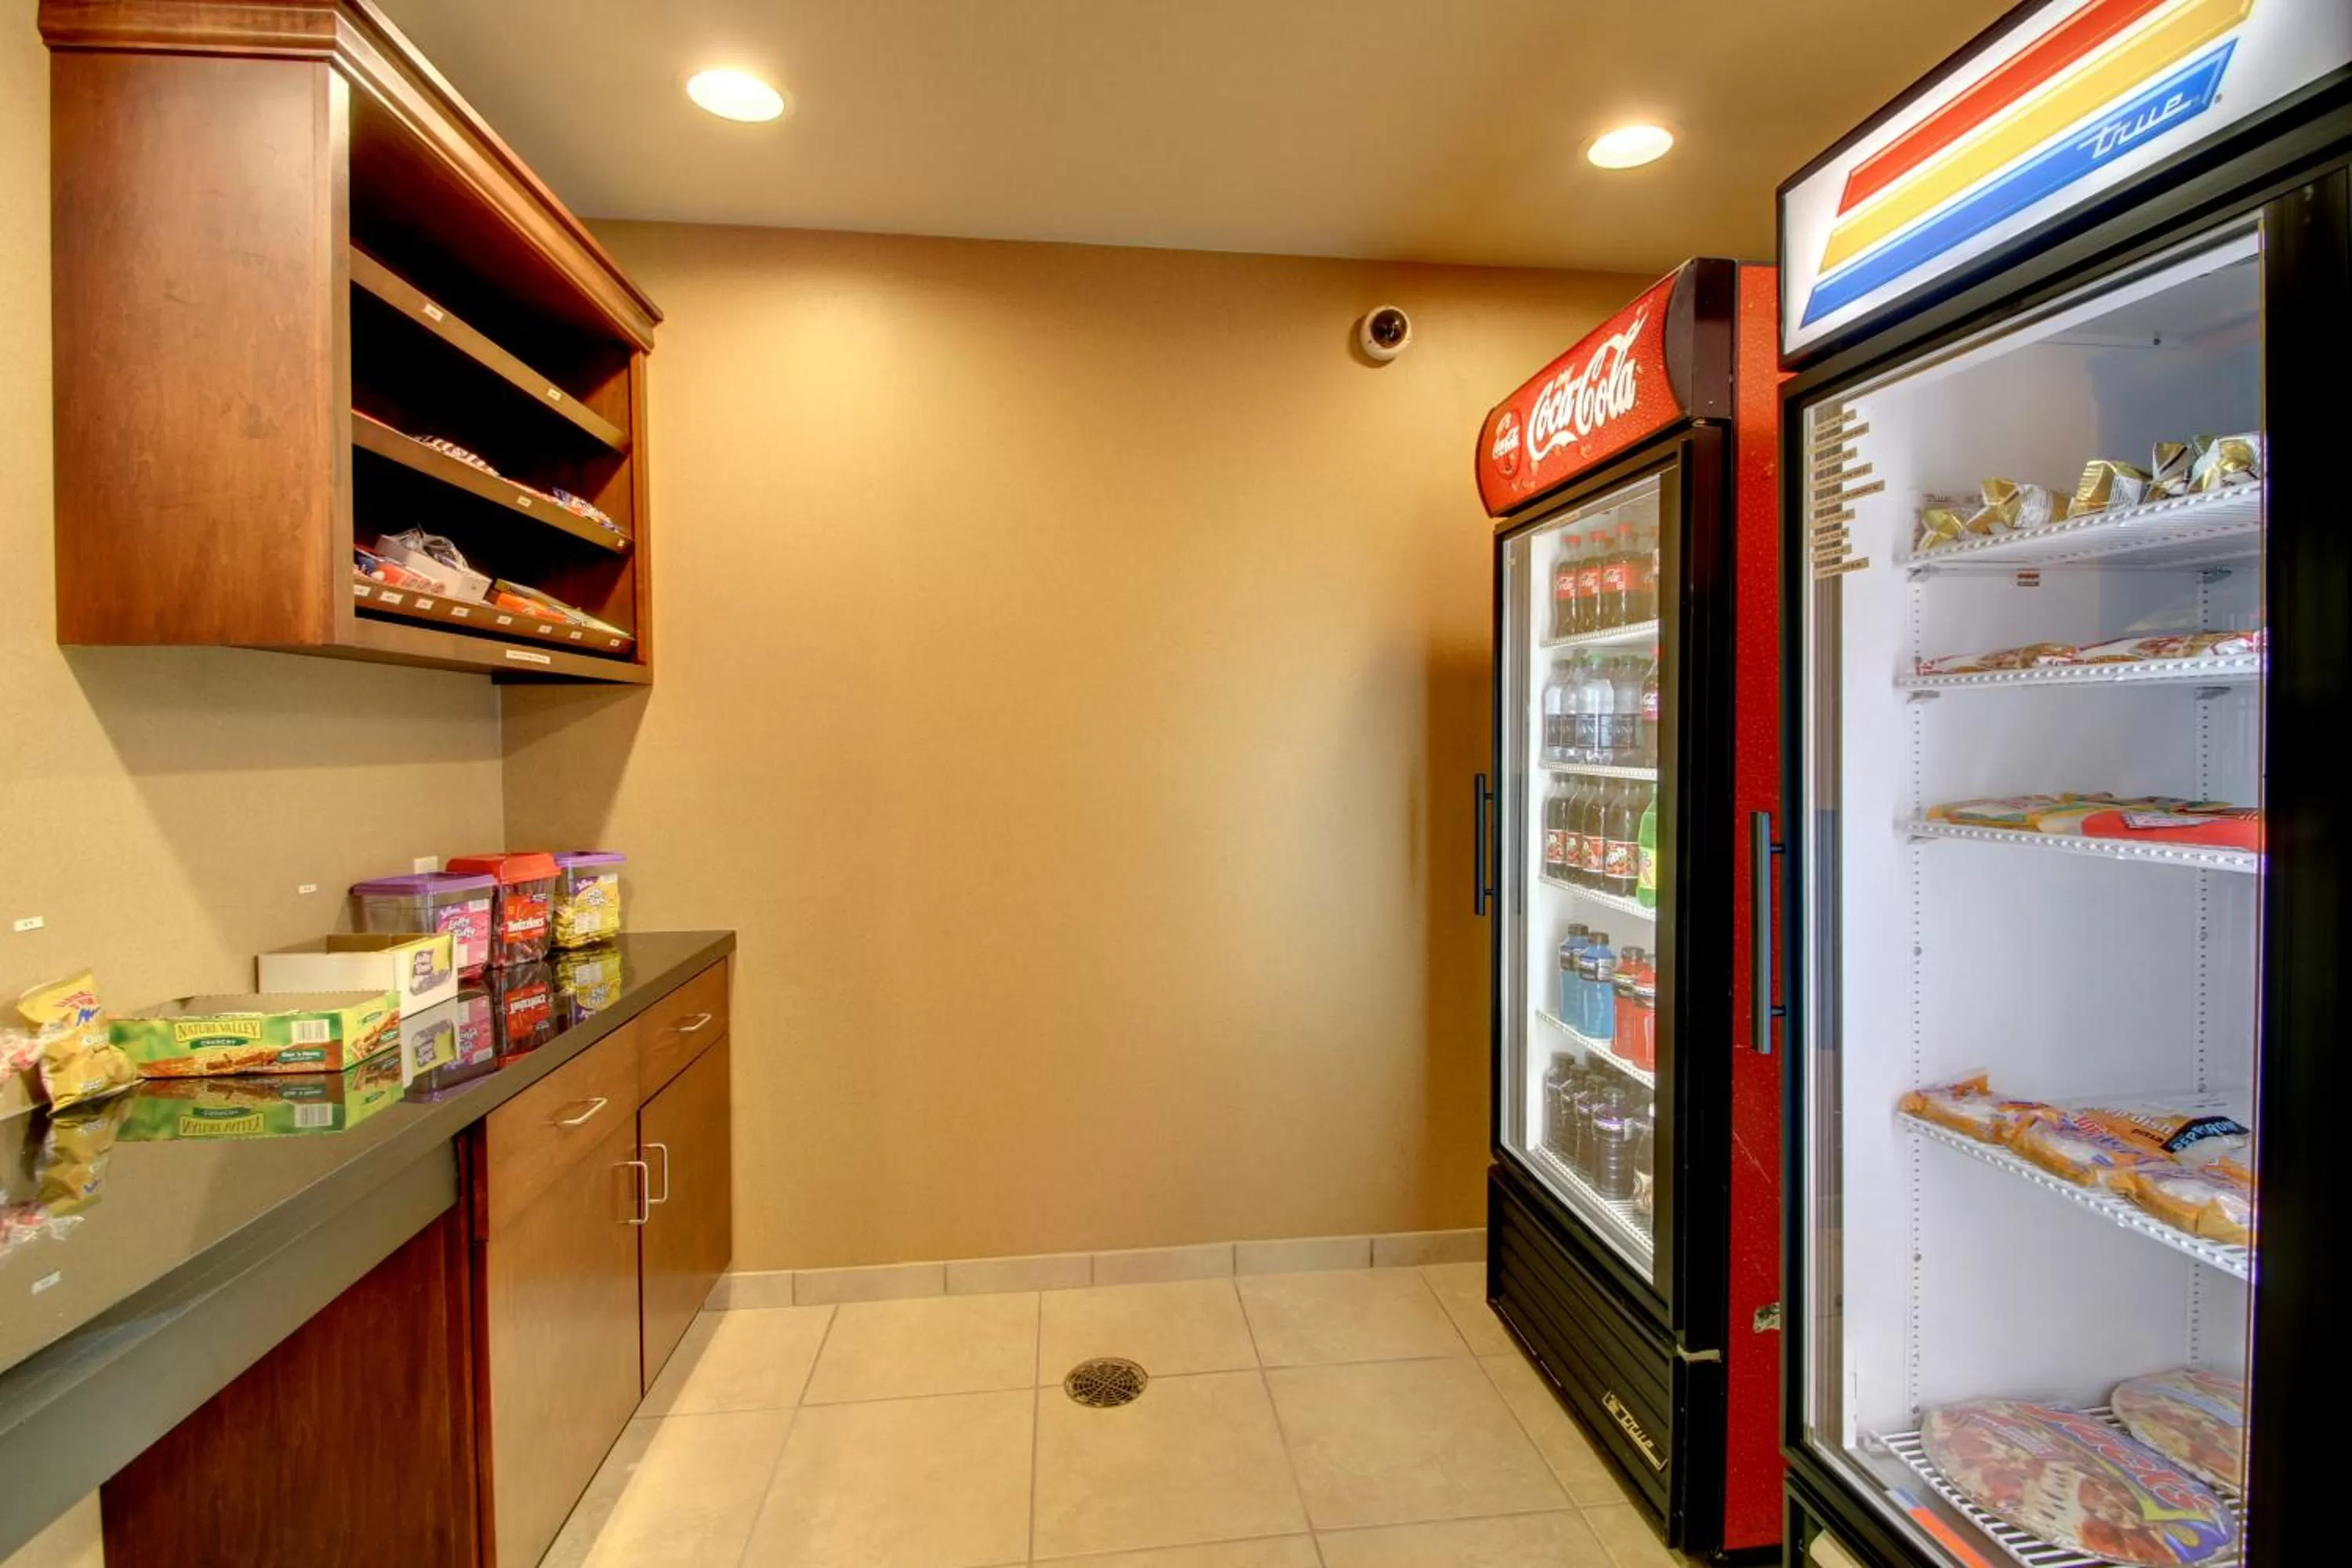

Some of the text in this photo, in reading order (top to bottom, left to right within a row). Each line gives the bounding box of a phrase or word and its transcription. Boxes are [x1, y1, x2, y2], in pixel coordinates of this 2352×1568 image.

[2076, 92, 2192, 159] true
[1527, 309, 1650, 462] Coca-Cola
[178, 1022, 259, 1040] NATURE VALLEY
